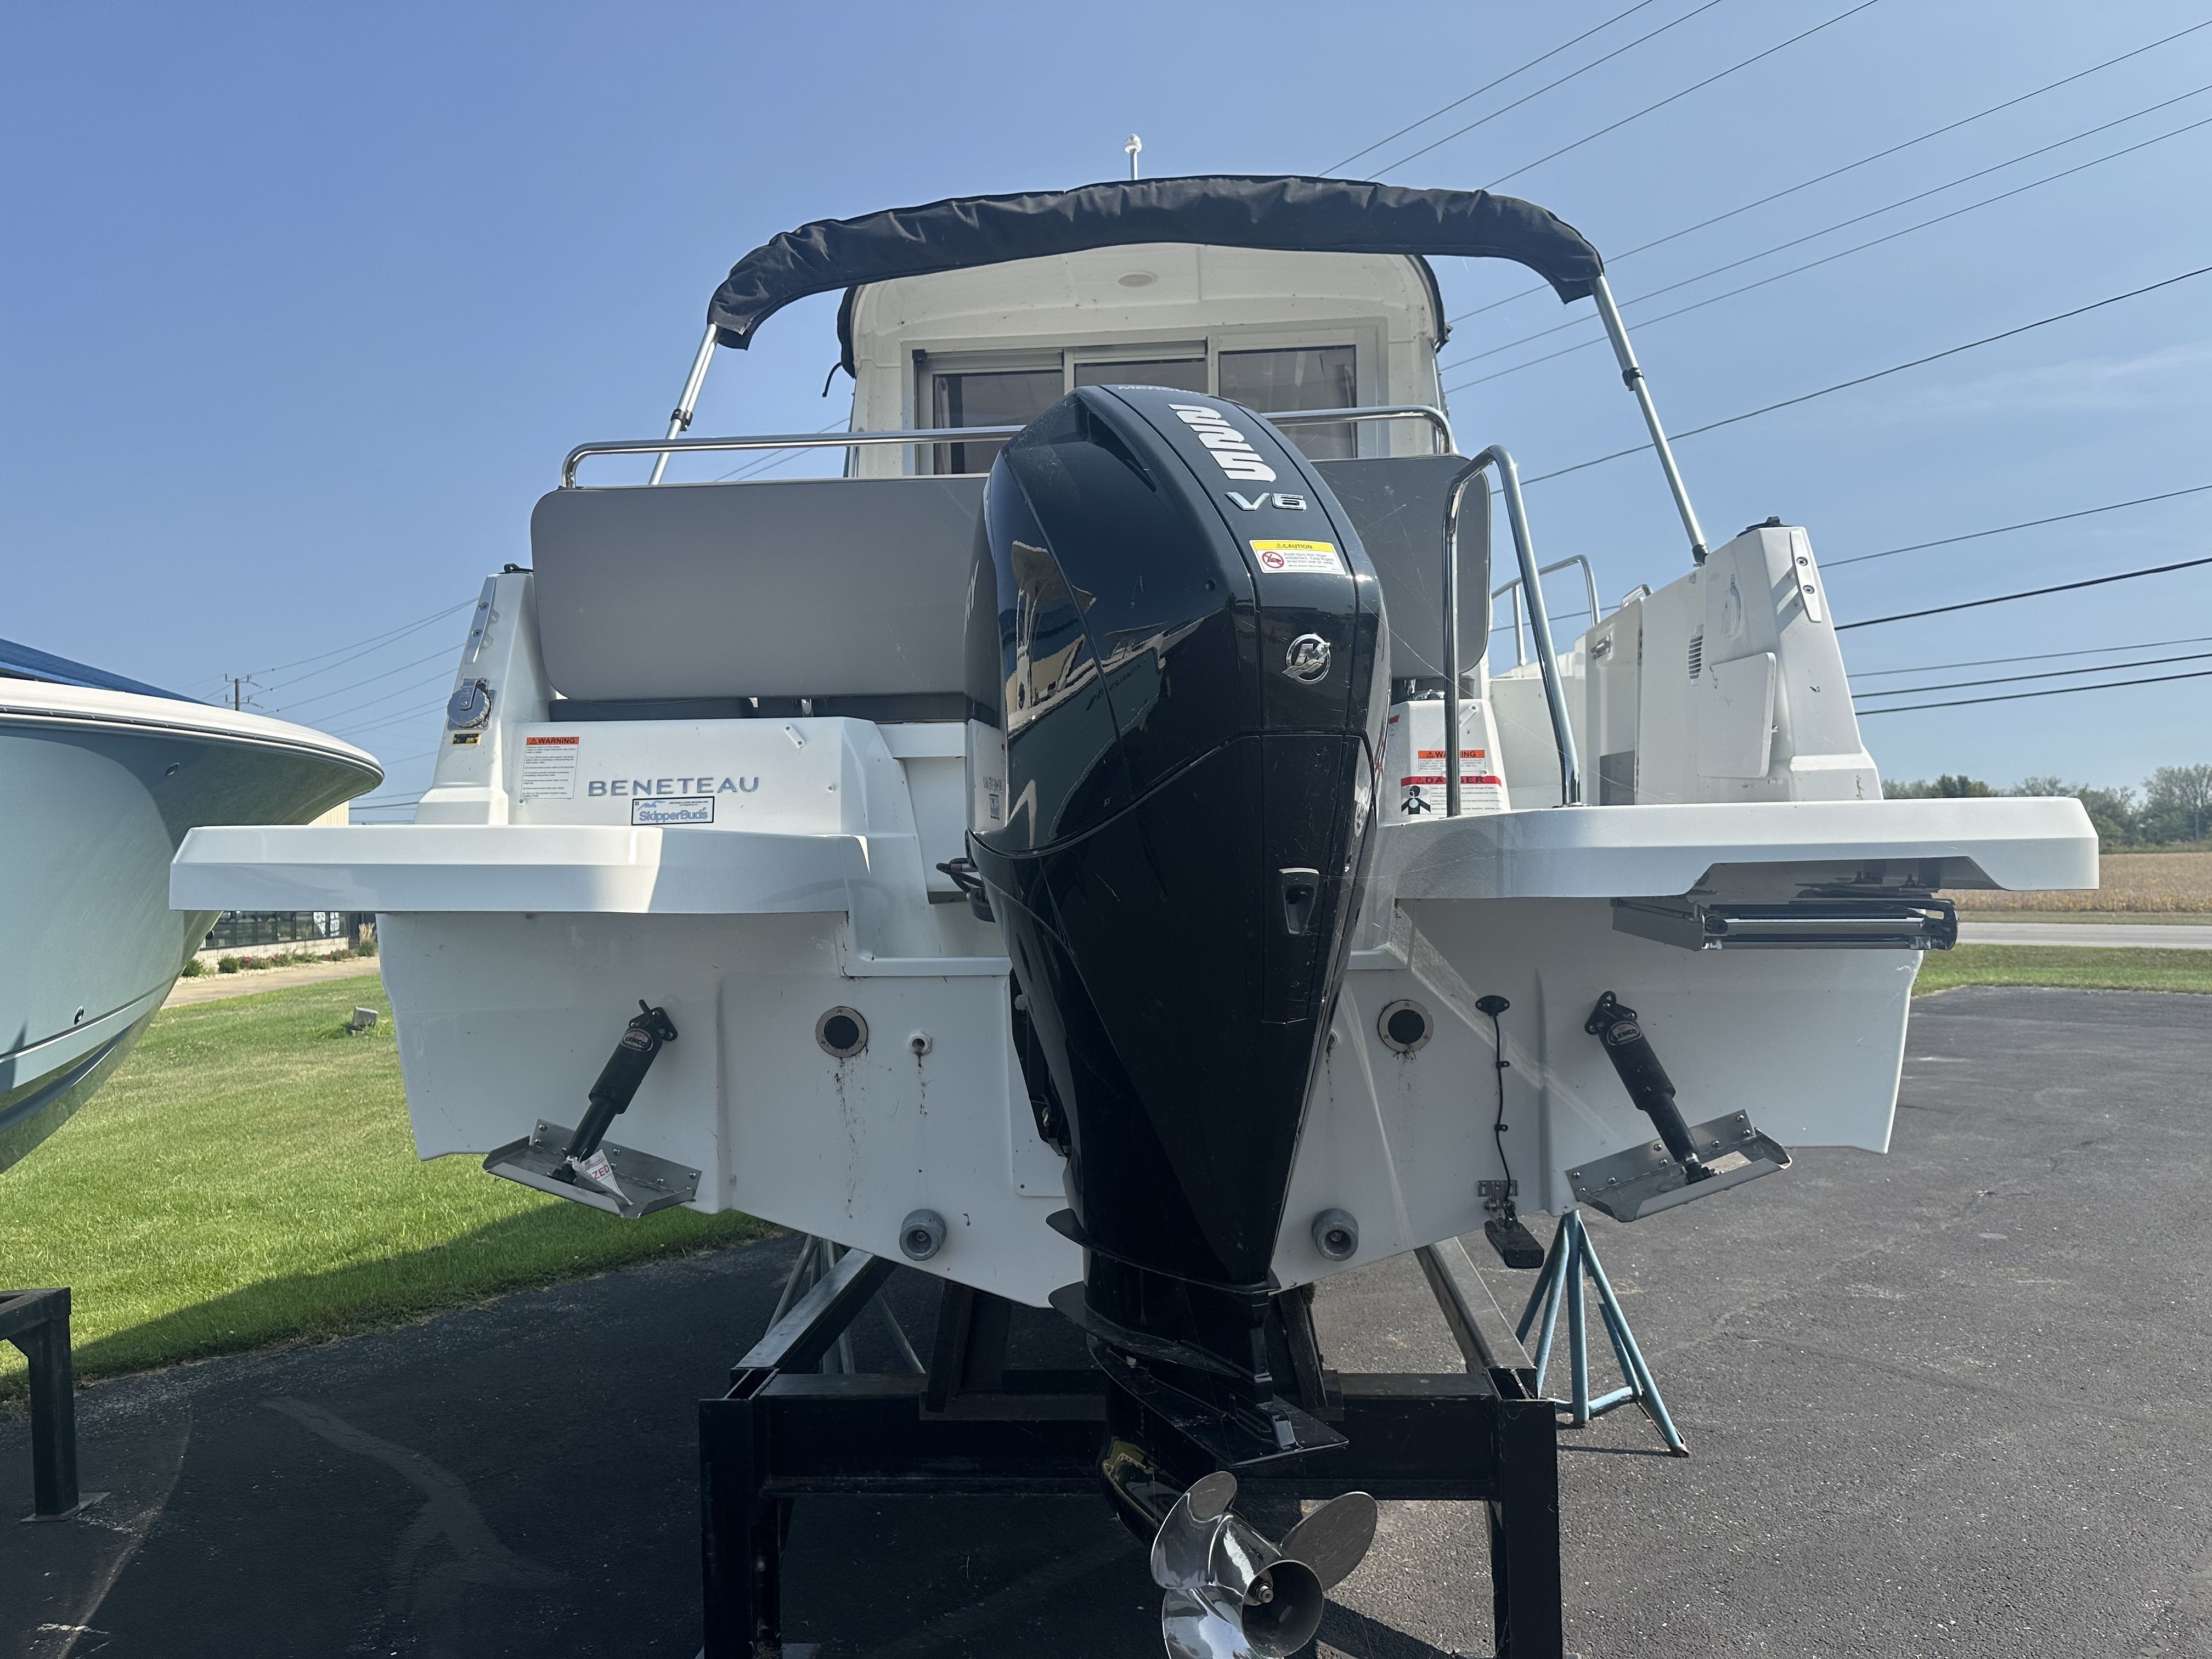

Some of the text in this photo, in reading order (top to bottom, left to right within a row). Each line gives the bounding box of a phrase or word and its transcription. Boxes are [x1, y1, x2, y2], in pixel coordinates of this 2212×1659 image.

[1118, 386, 1207, 397] MERCUR
[1224, 492, 1307, 510] V6
[588, 777, 759, 796] BENETEAU
[625, 1036, 646, 1047] LENCO
